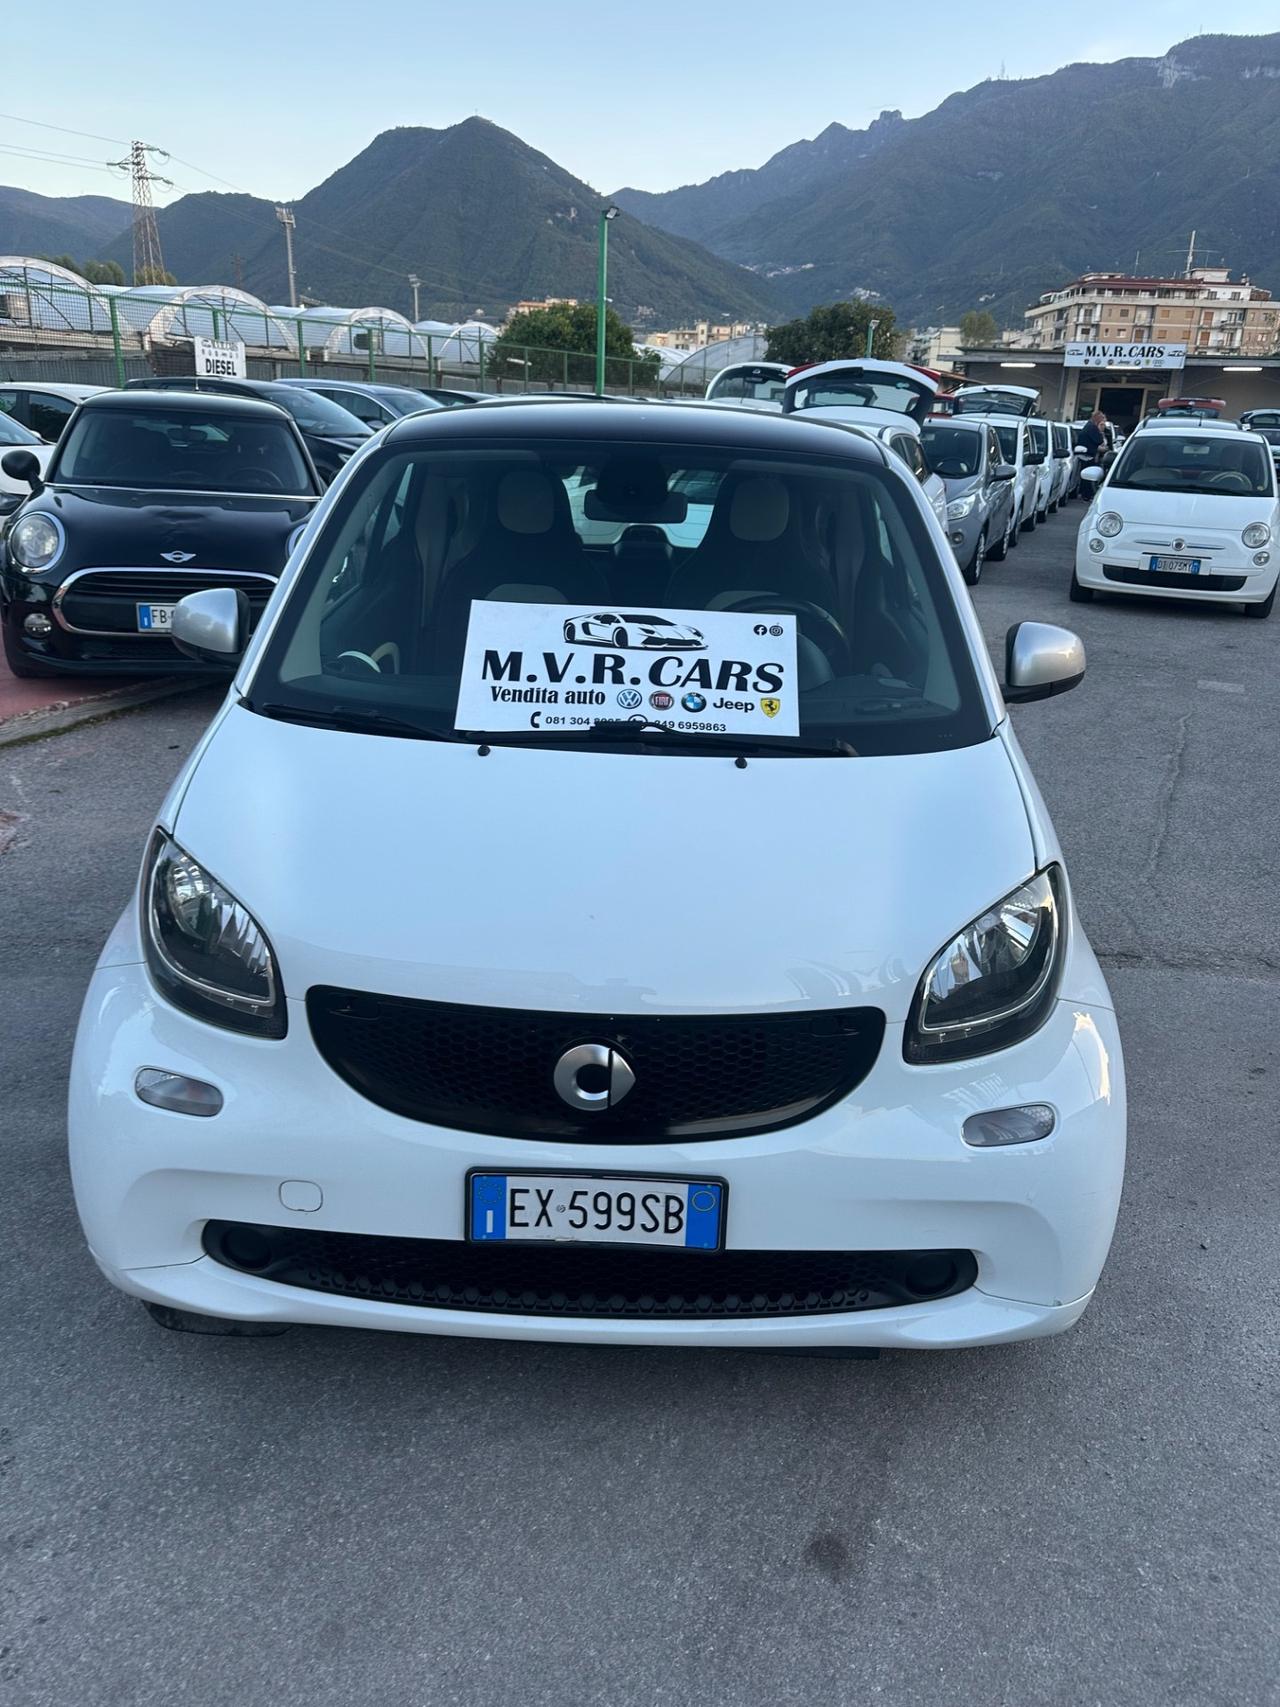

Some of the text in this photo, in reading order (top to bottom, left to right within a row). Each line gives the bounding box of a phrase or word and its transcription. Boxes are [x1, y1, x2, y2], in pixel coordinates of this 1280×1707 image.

[205, 358, 237, 376] DIESEL
[490, 685, 606, 705] Vendita auto
[713, 697, 755, 713] Jeep
[545, 716, 566, 725] 081
[570, 717, 590, 726] 304
[678, 721, 727, 732] 6959863
